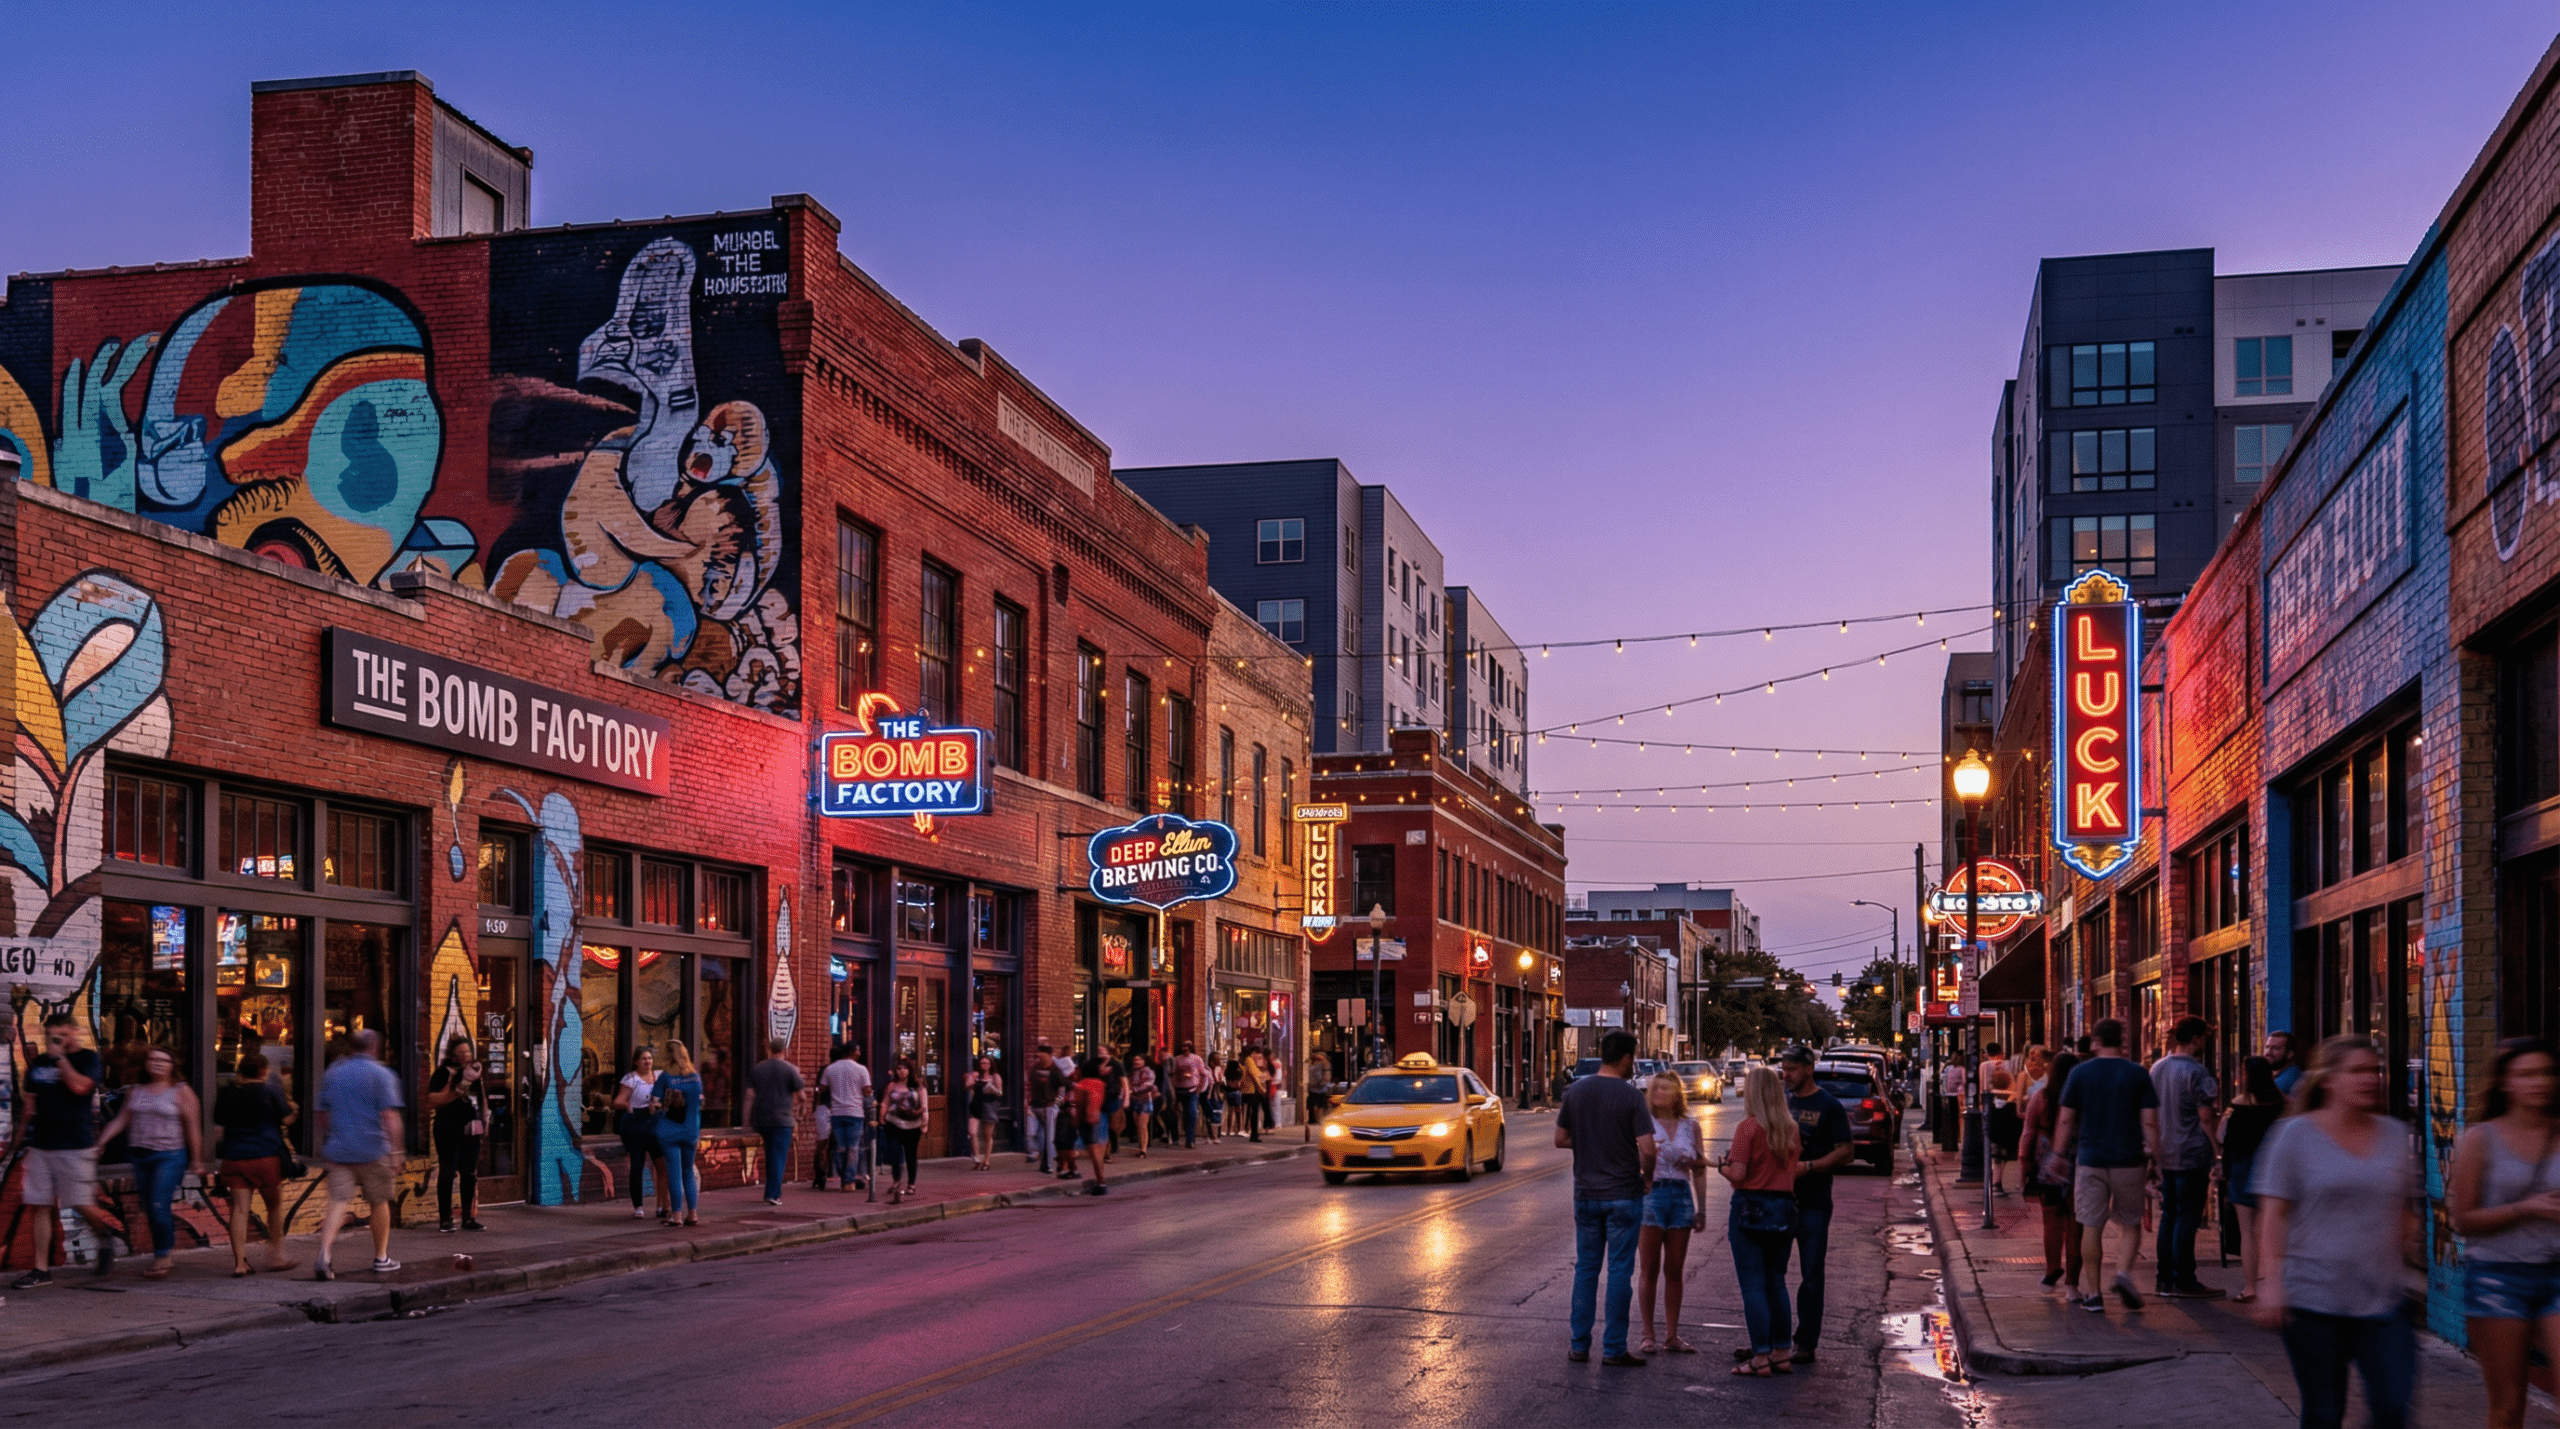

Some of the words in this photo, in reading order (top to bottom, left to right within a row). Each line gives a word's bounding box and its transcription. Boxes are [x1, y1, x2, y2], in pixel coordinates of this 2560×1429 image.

[720, 253, 761, 273] THE
[352, 649, 406, 706] THE
[418, 666, 518, 746] BOMB
[531, 697, 657, 780] FACTORY
[879, 720, 921, 739] THE
[2075, 615, 2122, 828] LUCK
[833, 741, 968, 778] BOMB
[835, 781, 963, 804] FACTORY
[1111, 841, 1156, 863] DEEP
[1101, 857, 1191, 888] BREWING
[1195, 853, 1224, 874] CO.
[1311, 825, 1327, 915] LUCKK
